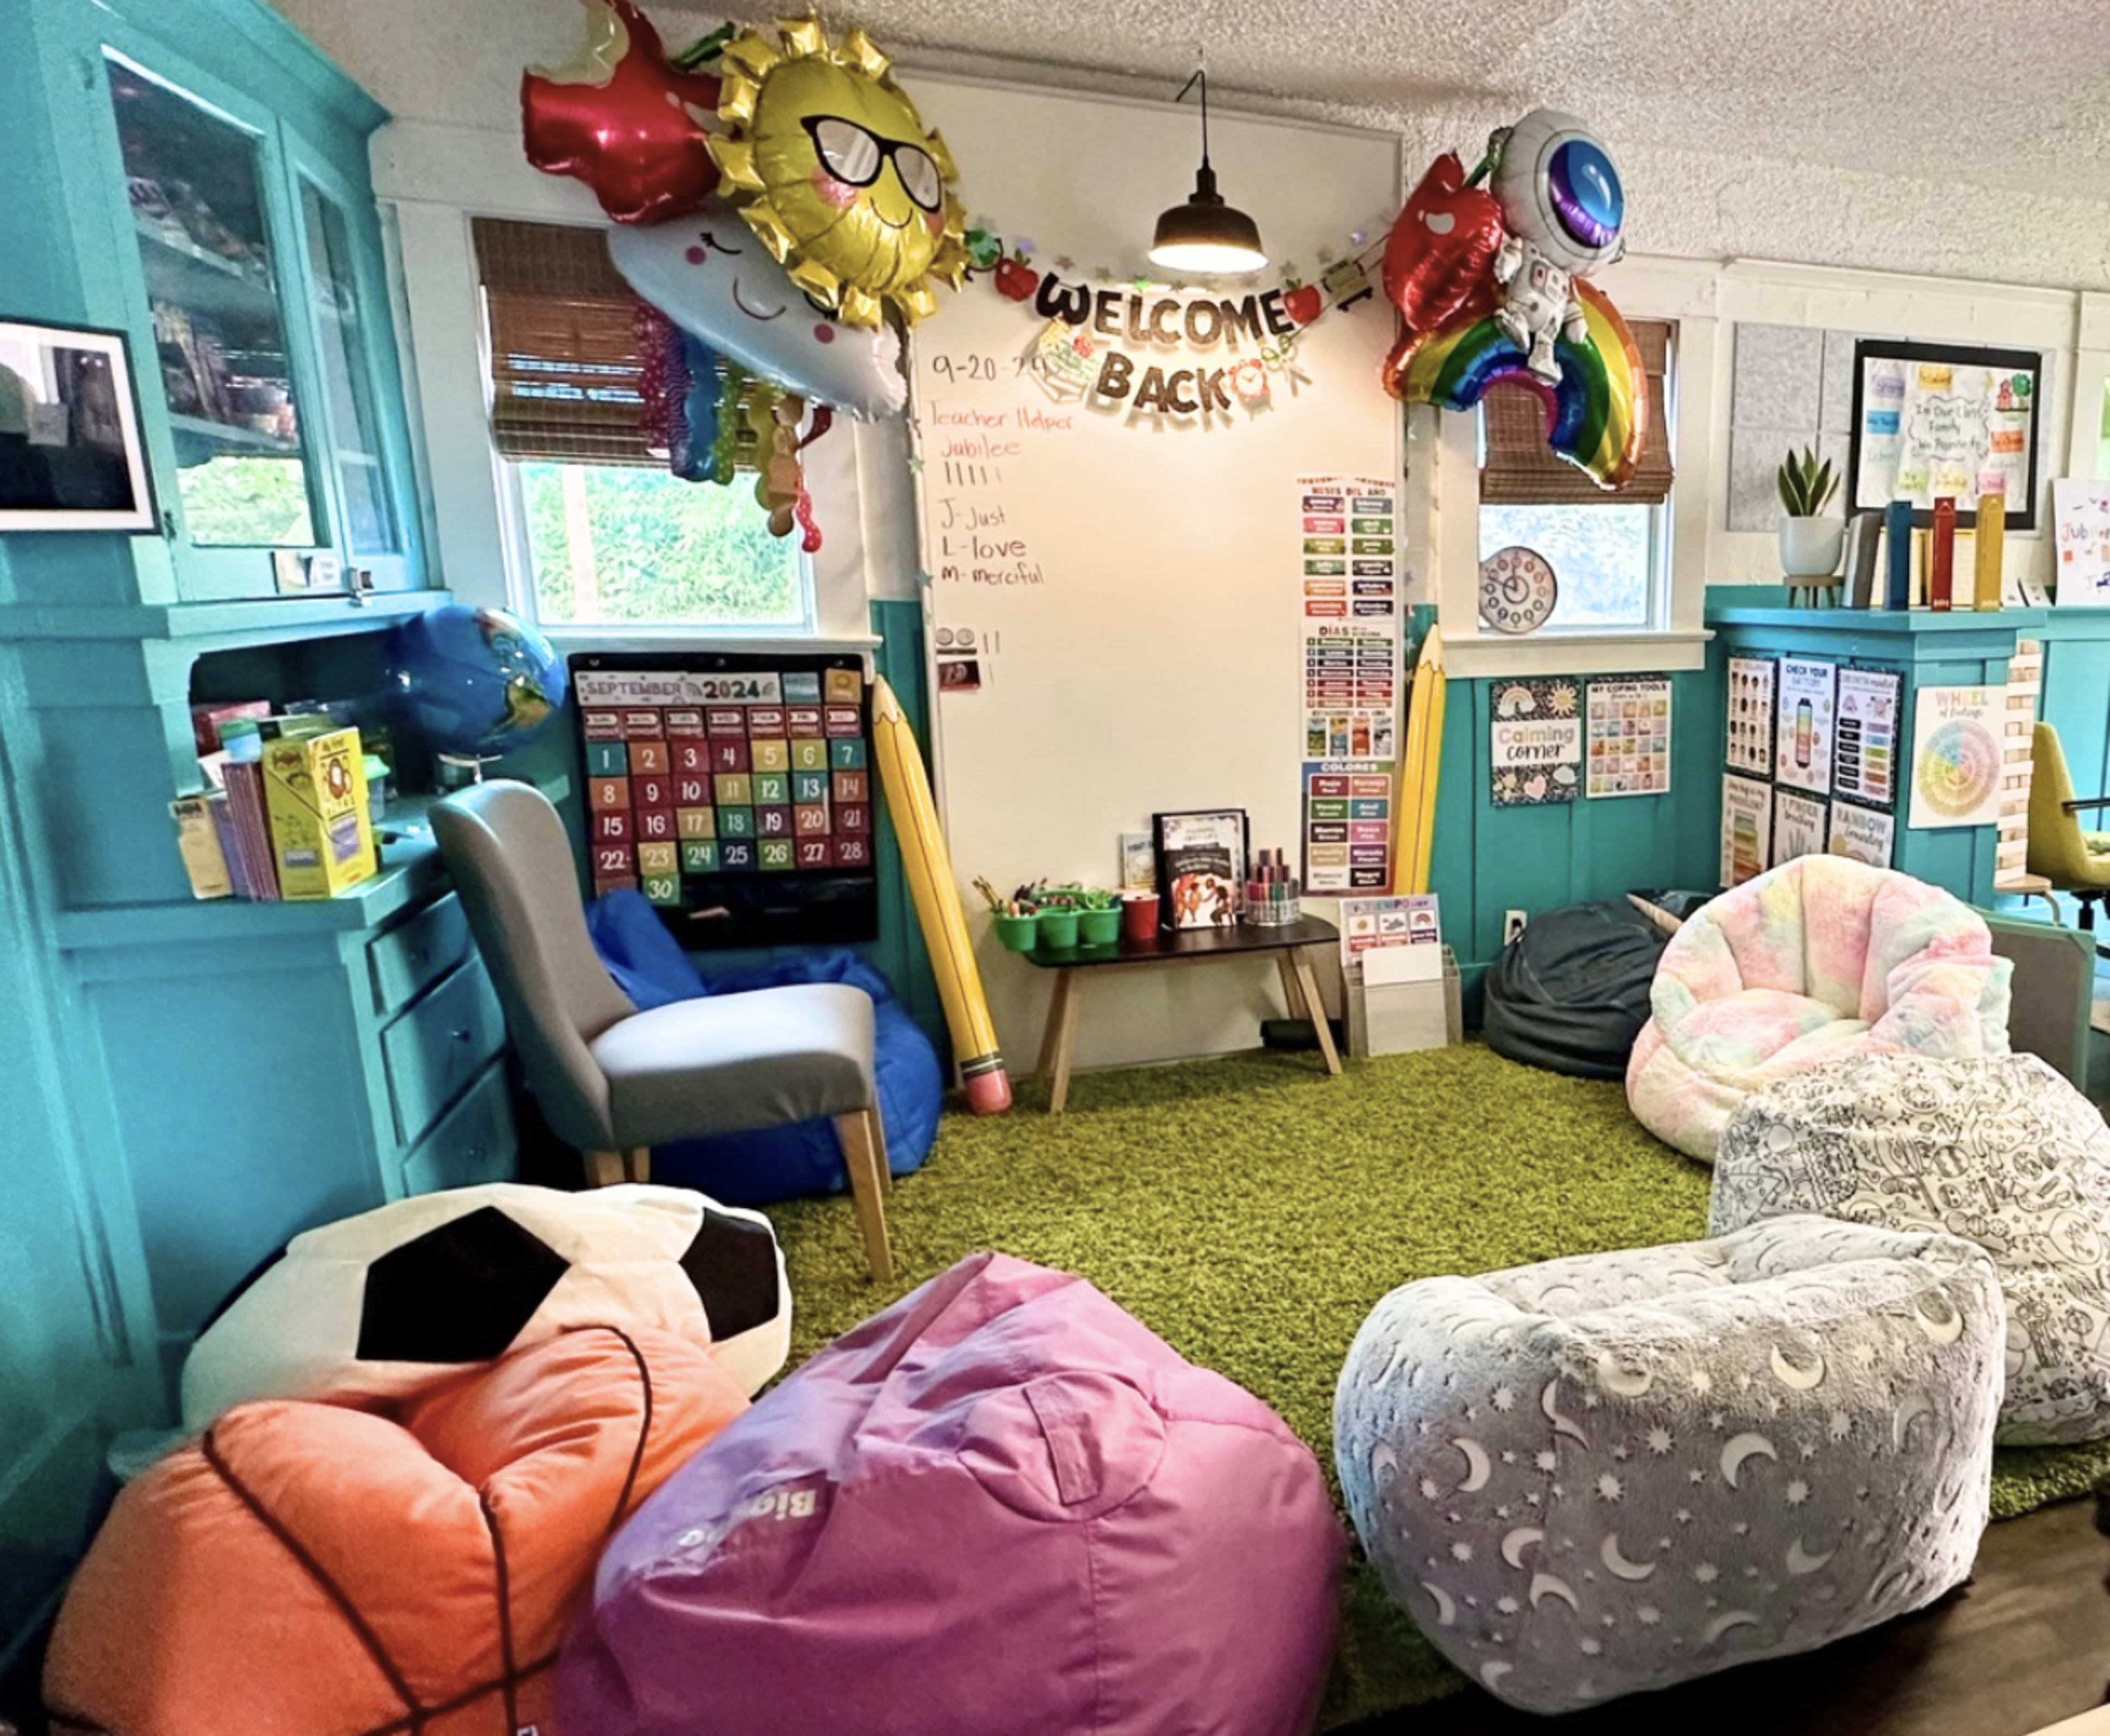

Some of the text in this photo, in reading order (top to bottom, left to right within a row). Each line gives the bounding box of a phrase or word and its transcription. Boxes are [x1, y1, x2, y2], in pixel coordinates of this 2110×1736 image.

[1036, 272, 1294, 345] WELCOME
[1097, 351, 1231, 413] BACK
[973, 536, 1026, 560] love
[1786, 665, 1828, 678] CHECK YOUR
[586, 680, 760, 698] SEPTEMBER 2024
[1936, 690, 1990, 706] WHEEL
[1498, 725, 1575, 744] Calming
[603, 746, 852, 768] 1 2 3 4 5 6 7
[1506, 742, 1565, 761] corner
[604, 779, 858, 802] 8 9 10 11 12 13 14
[604, 810, 860, 835] 15 16 17 18 19 20 21
[601, 842, 862, 869] 22 23 24 25 26 27 28
[648, 880, 672, 898] 30
